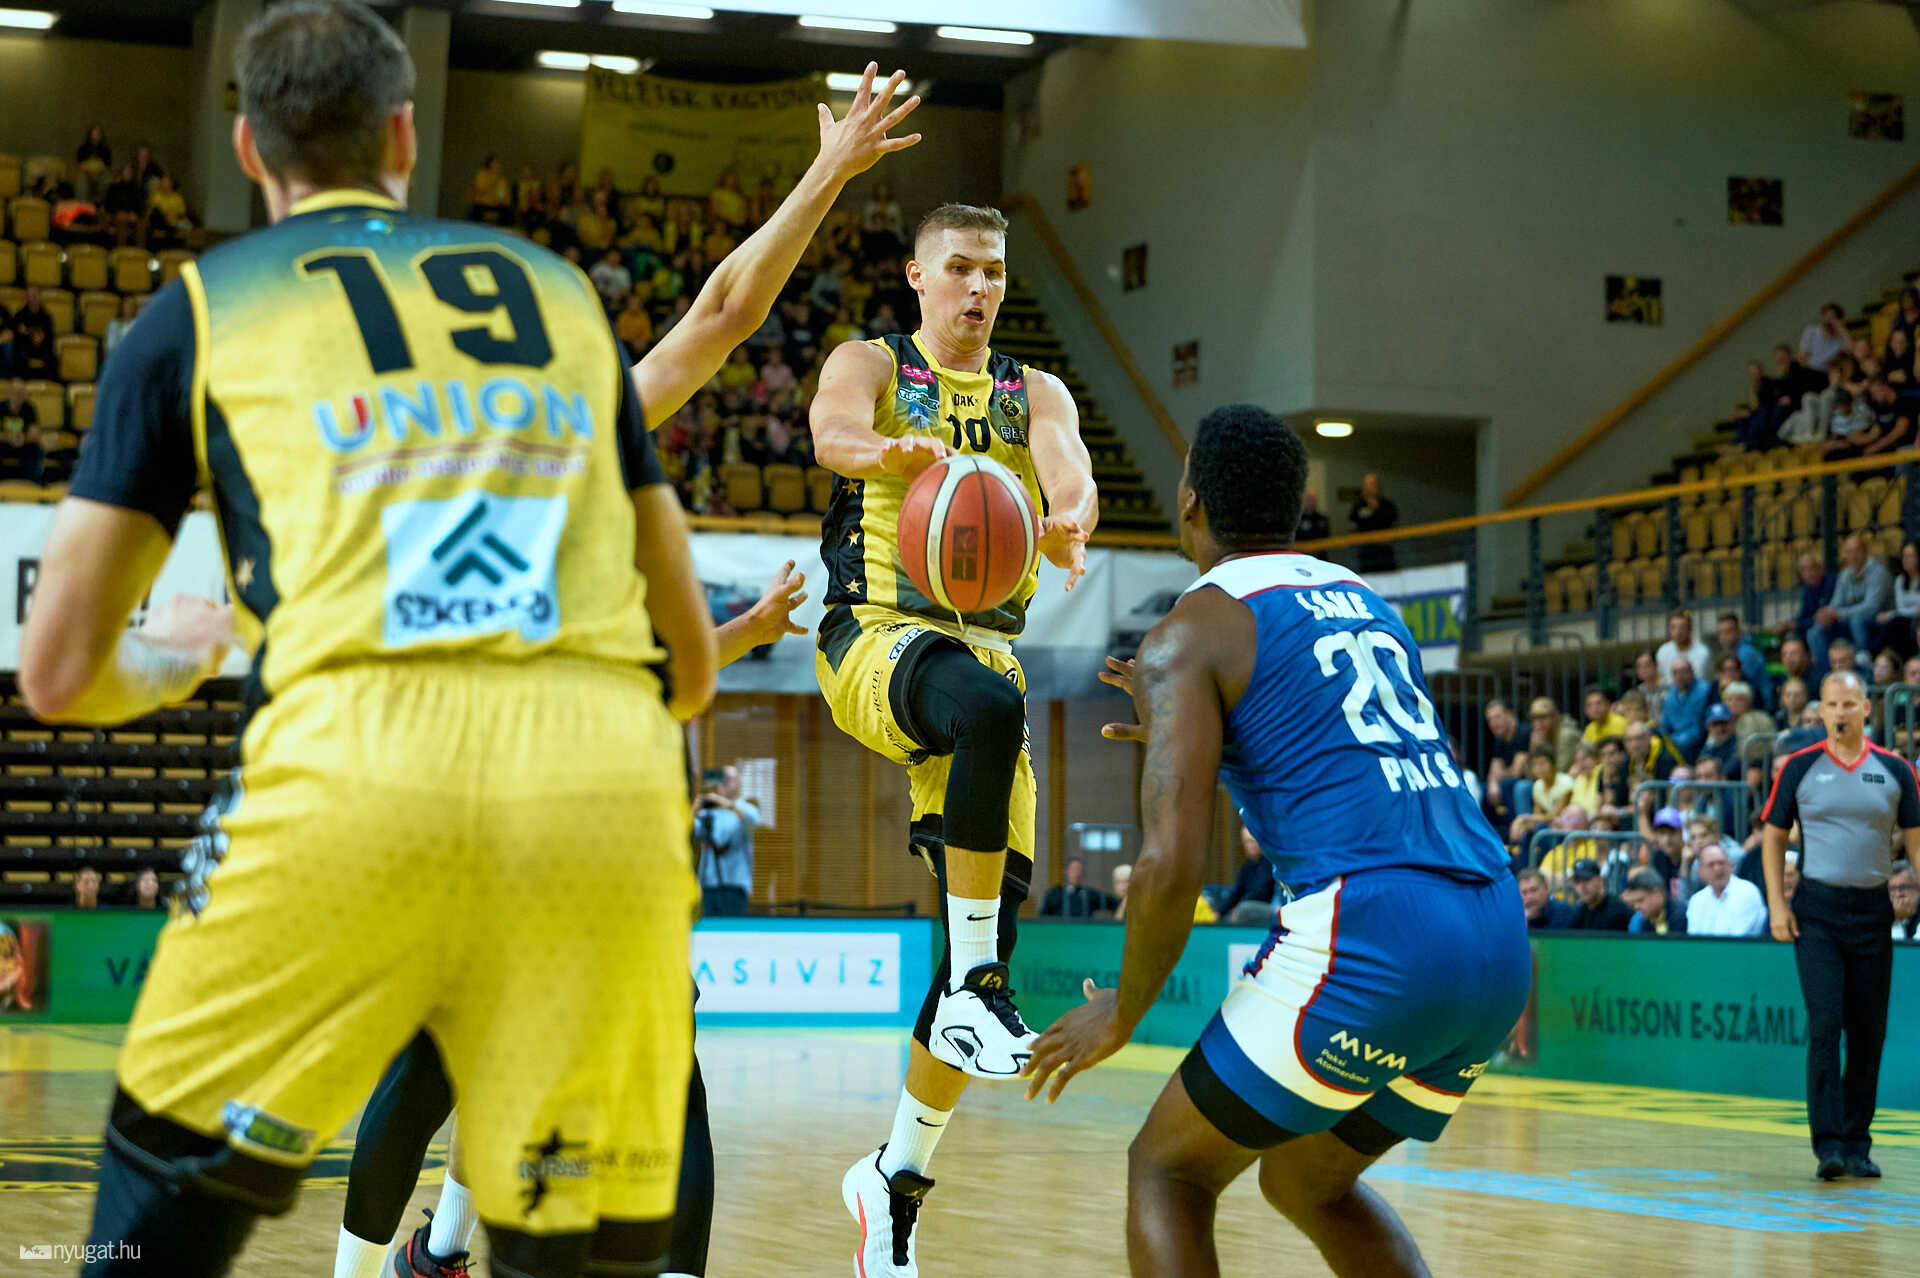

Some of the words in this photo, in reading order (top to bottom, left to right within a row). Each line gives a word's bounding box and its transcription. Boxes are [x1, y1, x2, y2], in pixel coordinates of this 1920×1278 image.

[295, 244, 556, 376] 19
[312, 377, 596, 453] UNION
[946, 414, 991, 453] 10
[1313, 630, 1440, 744] 20
[1571, 988, 1681, 1038] VÁLTSON
[1329, 1030, 1407, 1070] MVM
